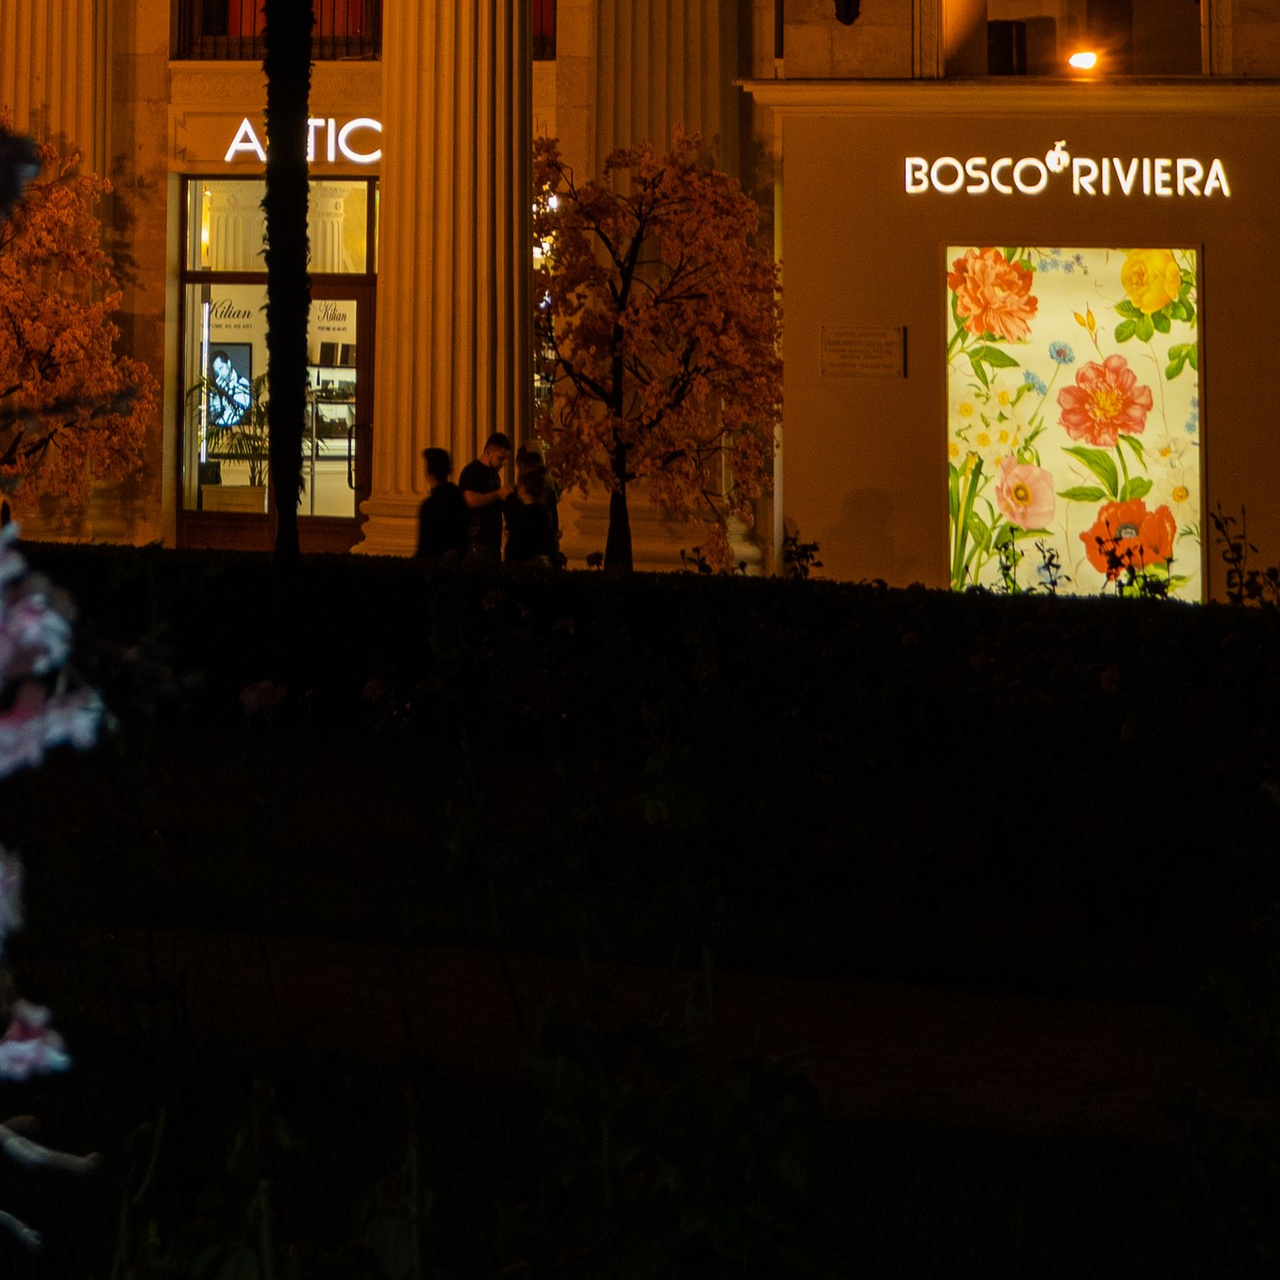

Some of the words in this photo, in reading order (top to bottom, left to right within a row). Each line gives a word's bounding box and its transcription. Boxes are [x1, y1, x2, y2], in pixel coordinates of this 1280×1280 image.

[224, 116, 383, 164] ATIC
[905, 156, 1048, 195] BOSCO
[1072, 156, 1231, 198] RIVIERA
[210, 298, 253, 320] Kilian
[317, 300, 347, 322] Kilian
